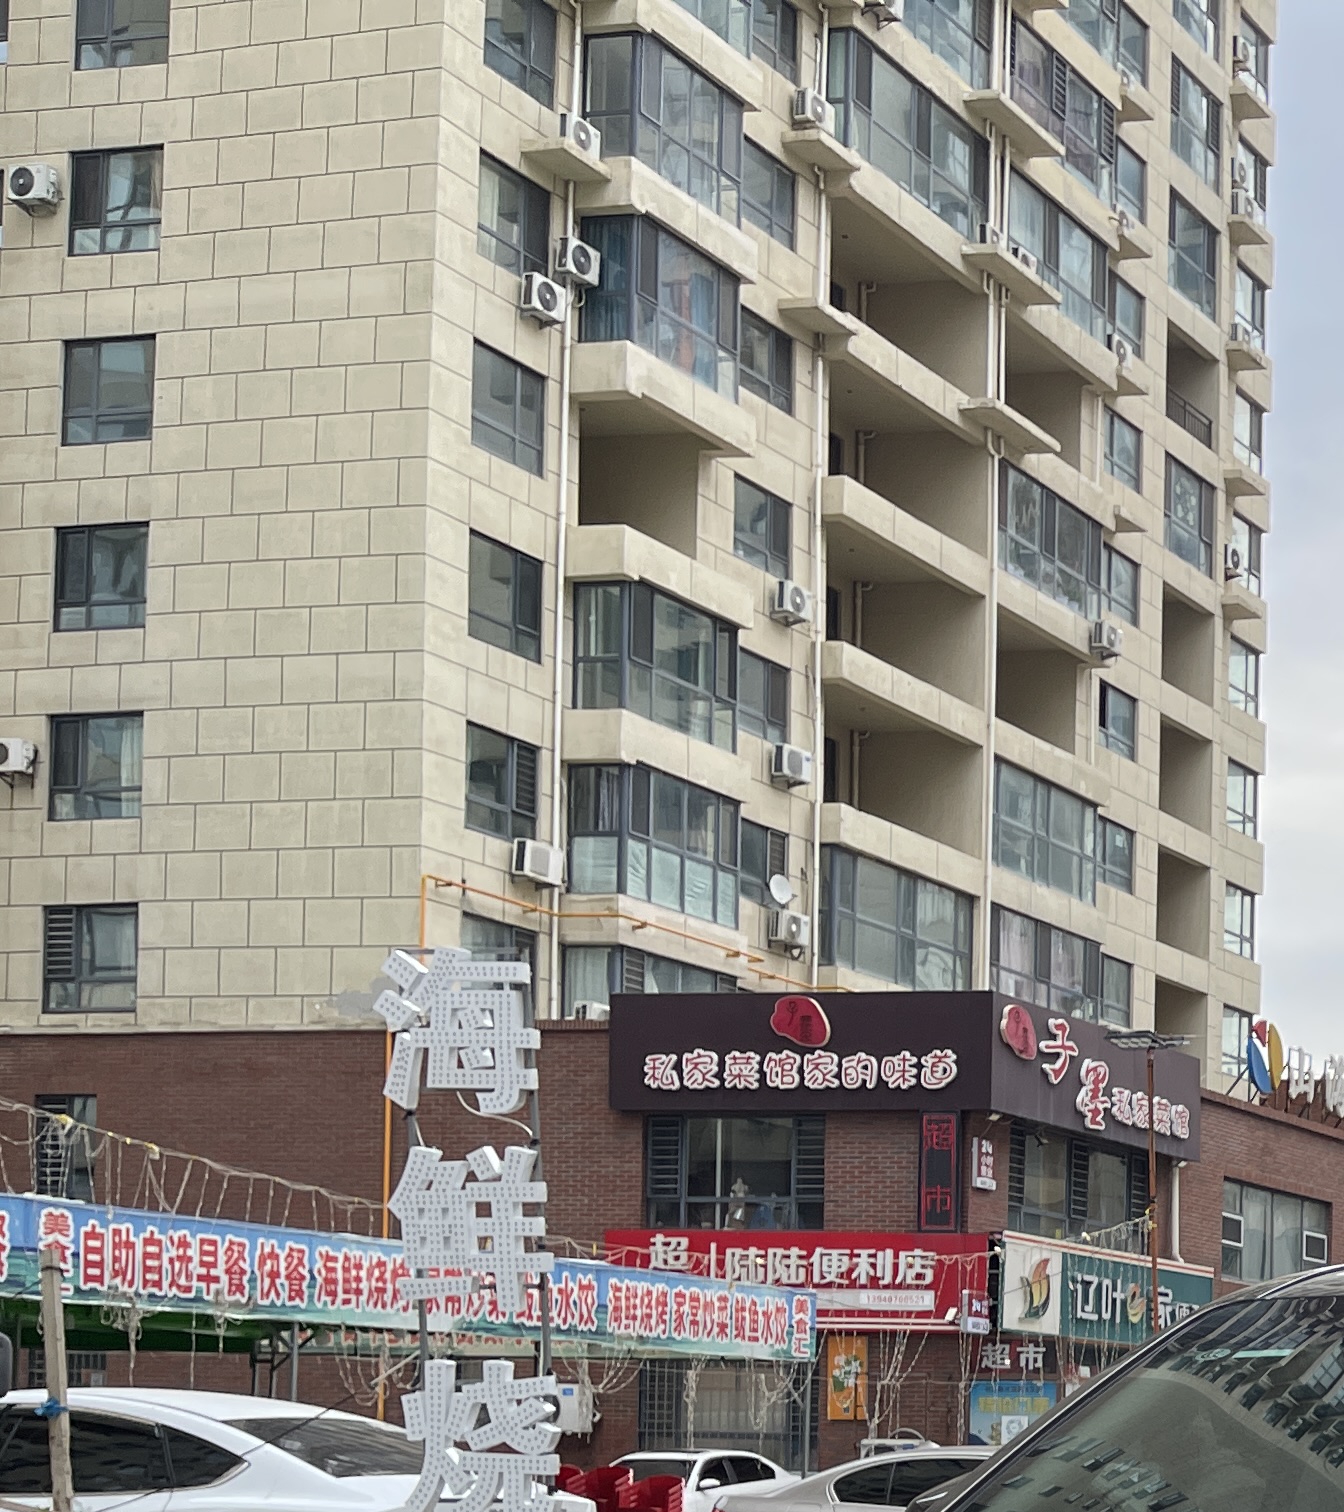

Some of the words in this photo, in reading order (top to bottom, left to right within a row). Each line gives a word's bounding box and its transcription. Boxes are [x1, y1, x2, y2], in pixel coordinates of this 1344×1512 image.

[643, 1048, 957, 1091] 私家菜馆家的味道
[81, 1220, 250, 1302] 自助自选早餐
[256, 1239, 309, 1305] 快餐
[607, 1277, 669, 1338] 海鲜烧烤
[671, 1285, 730, 1342] 家常炒菜
[726, 1246, 937, 1285] 陆陆便利店
[791, 1294, 812, 1357] 美食汇
[980, 1342, 1046, 1370] 超市
